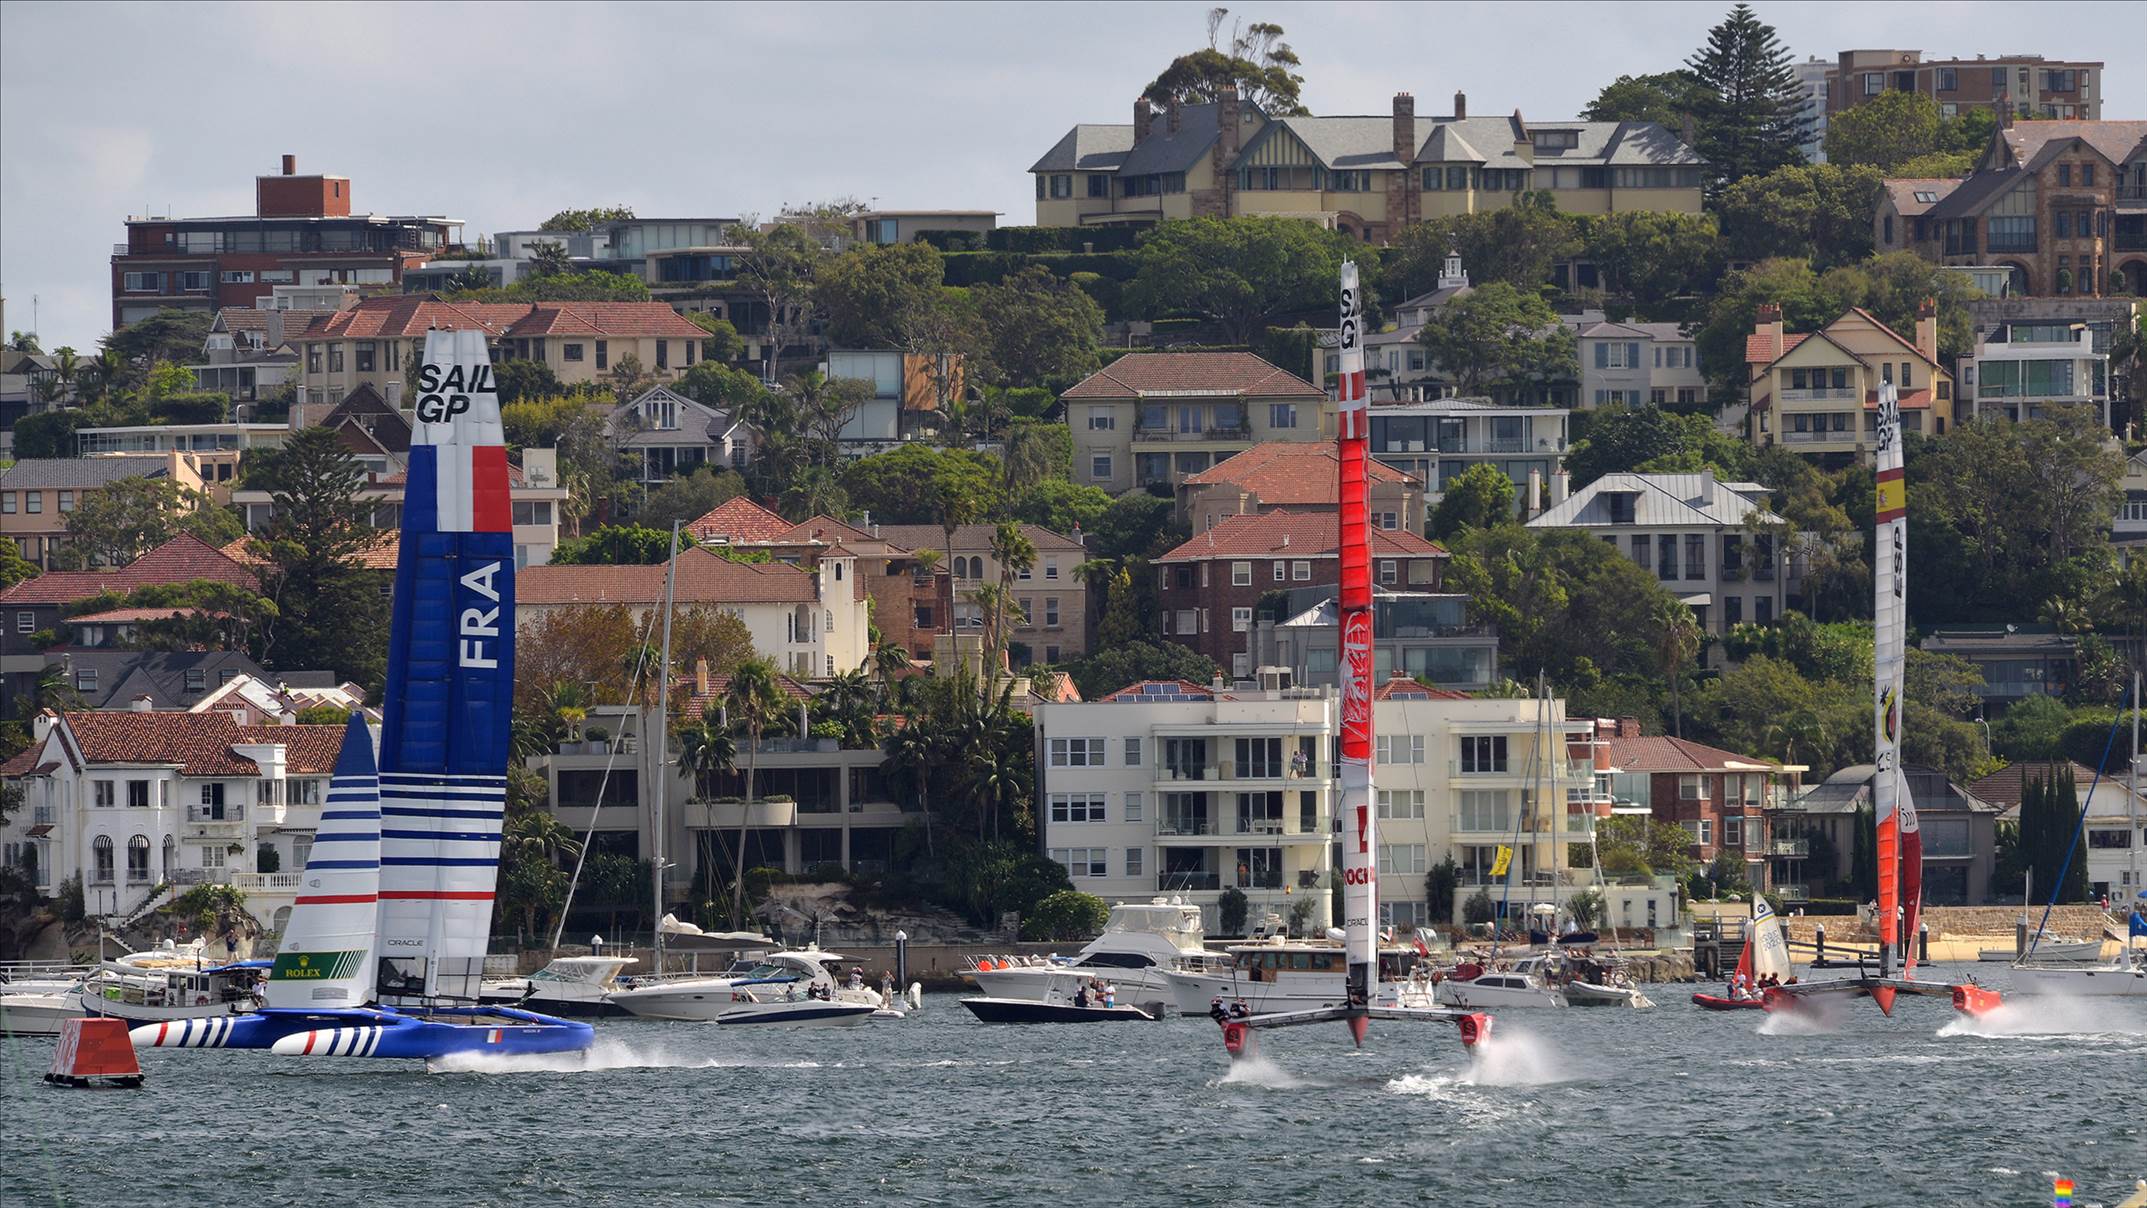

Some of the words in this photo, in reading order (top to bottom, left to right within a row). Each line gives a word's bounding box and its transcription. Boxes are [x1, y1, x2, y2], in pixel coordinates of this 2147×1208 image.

[419, 364, 497, 393] SAIL
[417, 394, 470, 423] GP
[1894, 526, 1903, 599] ESP
[459, 561, 501, 669] FRA
[388, 939, 424, 947] ORACLE
[285, 968, 321, 978] ROLEX
